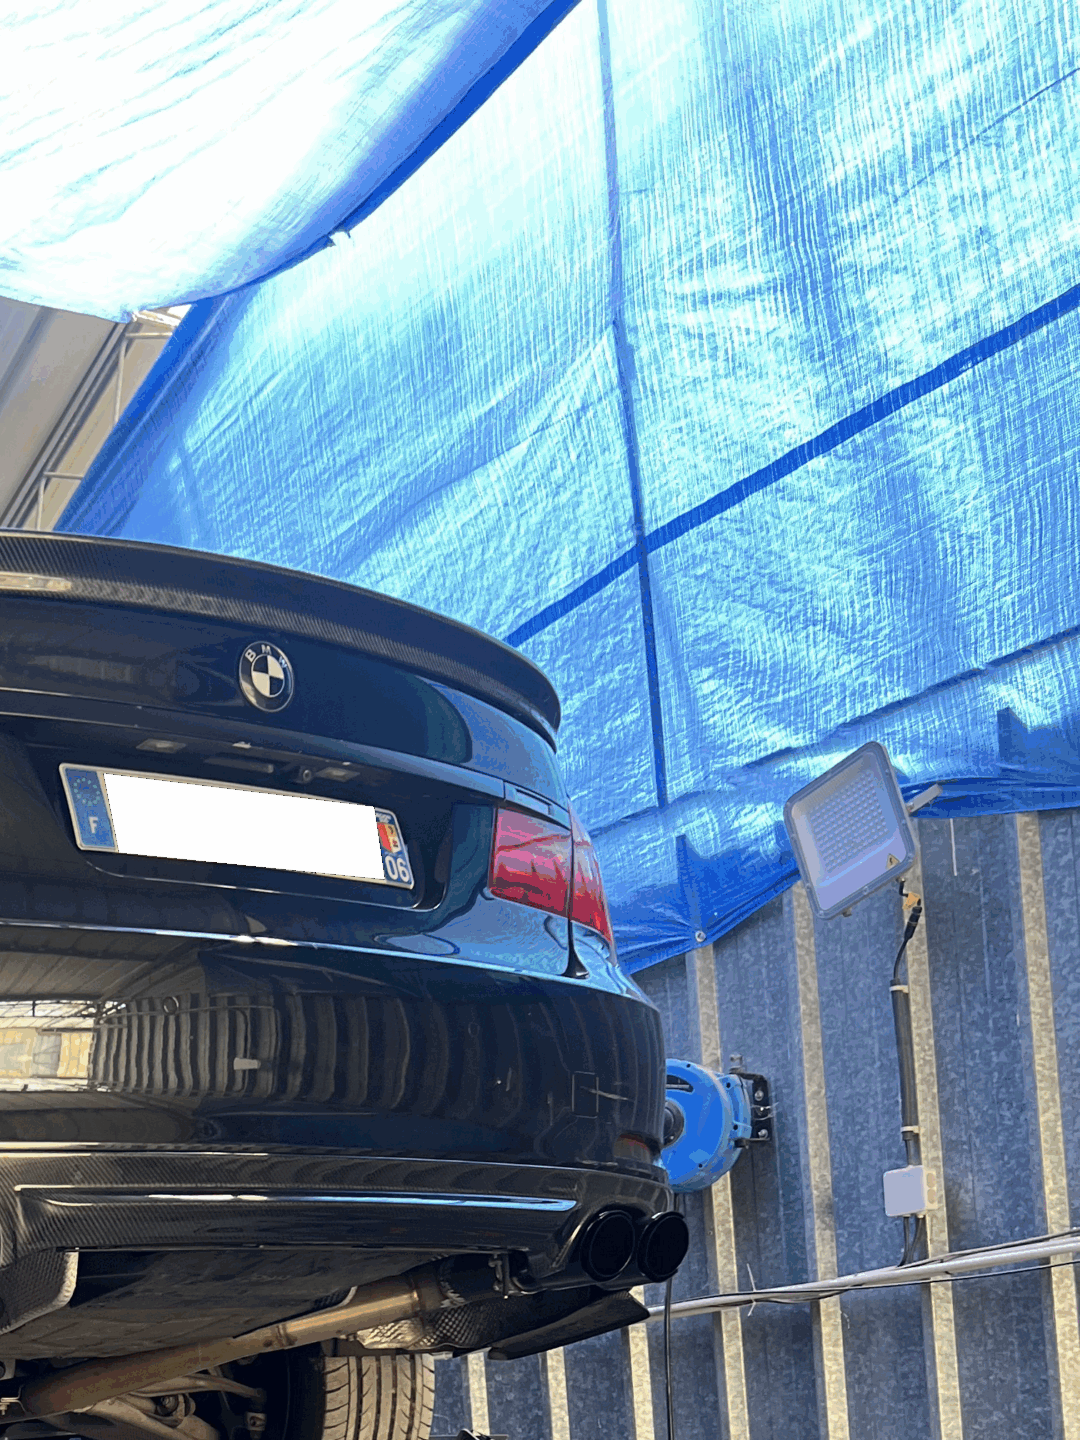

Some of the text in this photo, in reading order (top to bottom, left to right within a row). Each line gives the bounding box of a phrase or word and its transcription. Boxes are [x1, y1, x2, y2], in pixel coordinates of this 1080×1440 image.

[245, 644, 287, 668] BMW
[89, 816, 98, 834] F
[385, 855, 410, 882] 06
